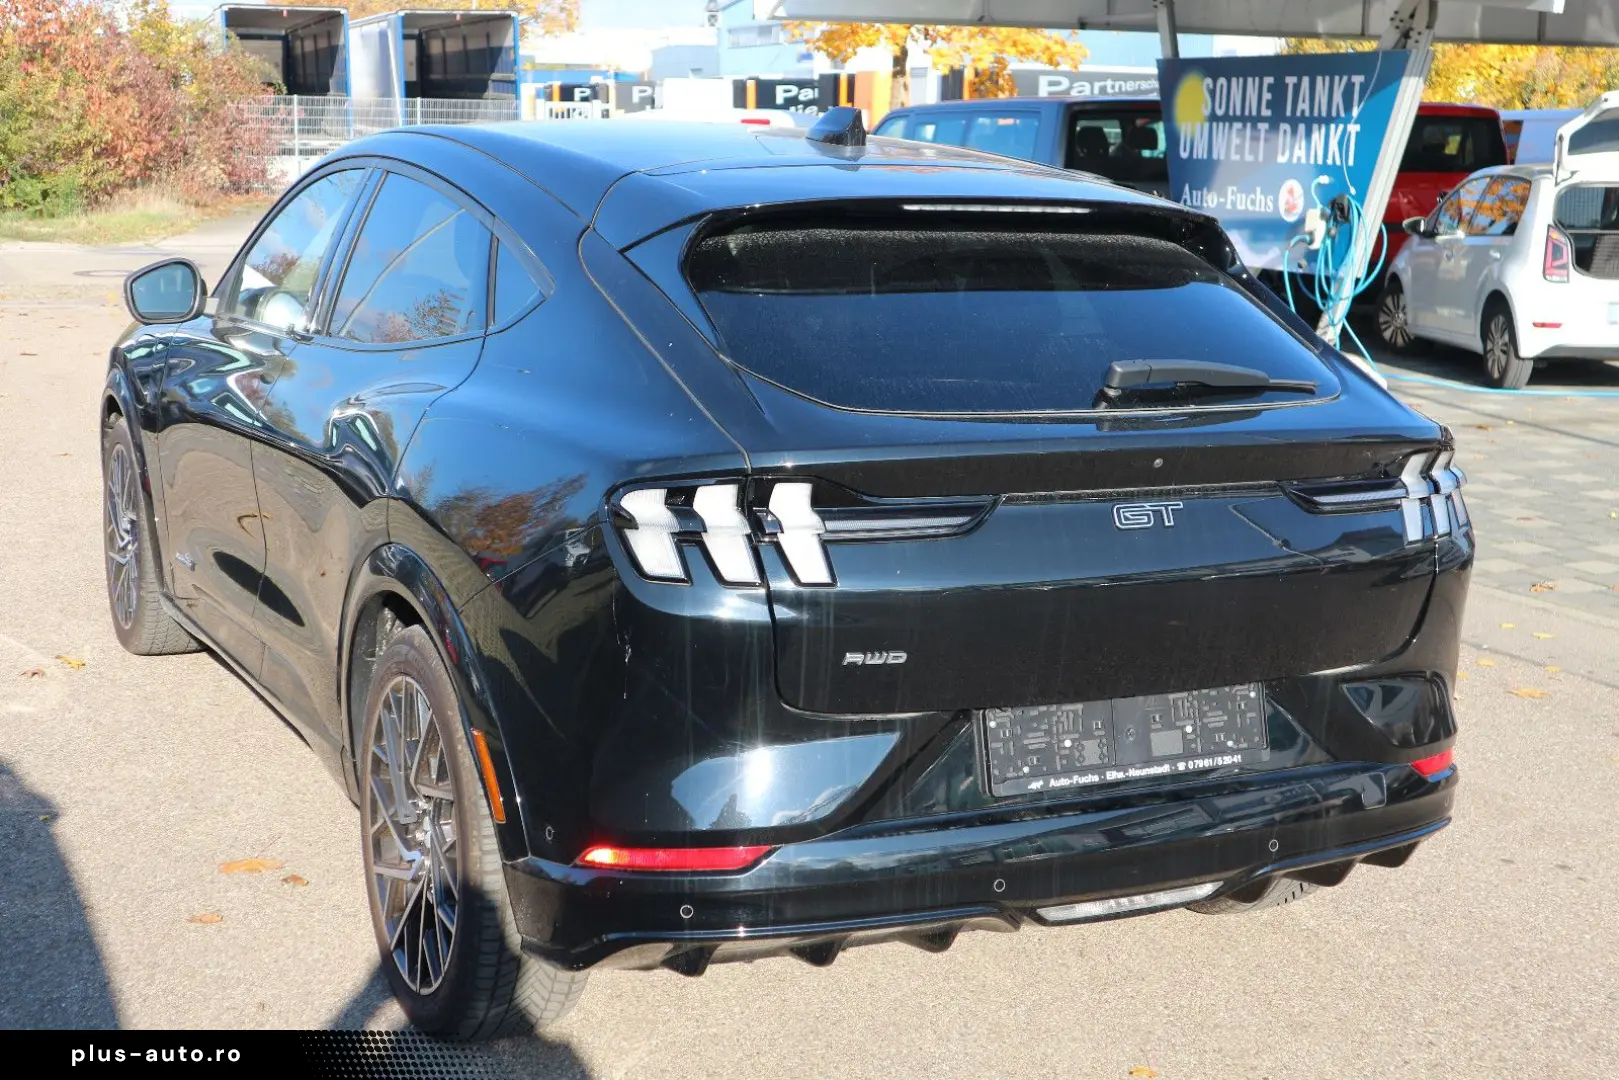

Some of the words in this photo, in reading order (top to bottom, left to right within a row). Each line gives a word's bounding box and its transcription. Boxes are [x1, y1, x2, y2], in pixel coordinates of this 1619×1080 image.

[1202, 75, 1275, 117] SONNE
[1285, 75, 1365, 118] TANKT
[1179, 121, 1270, 162] UMWELT
[1277, 123, 1361, 166] DANKT
[1180, 183, 1274, 213] Auto-Fuchs
[1113, 501, 1183, 529] GT
[842, 650, 908, 665] AWD
[1048, 773, 1100, 788] Auto-Fuchs
